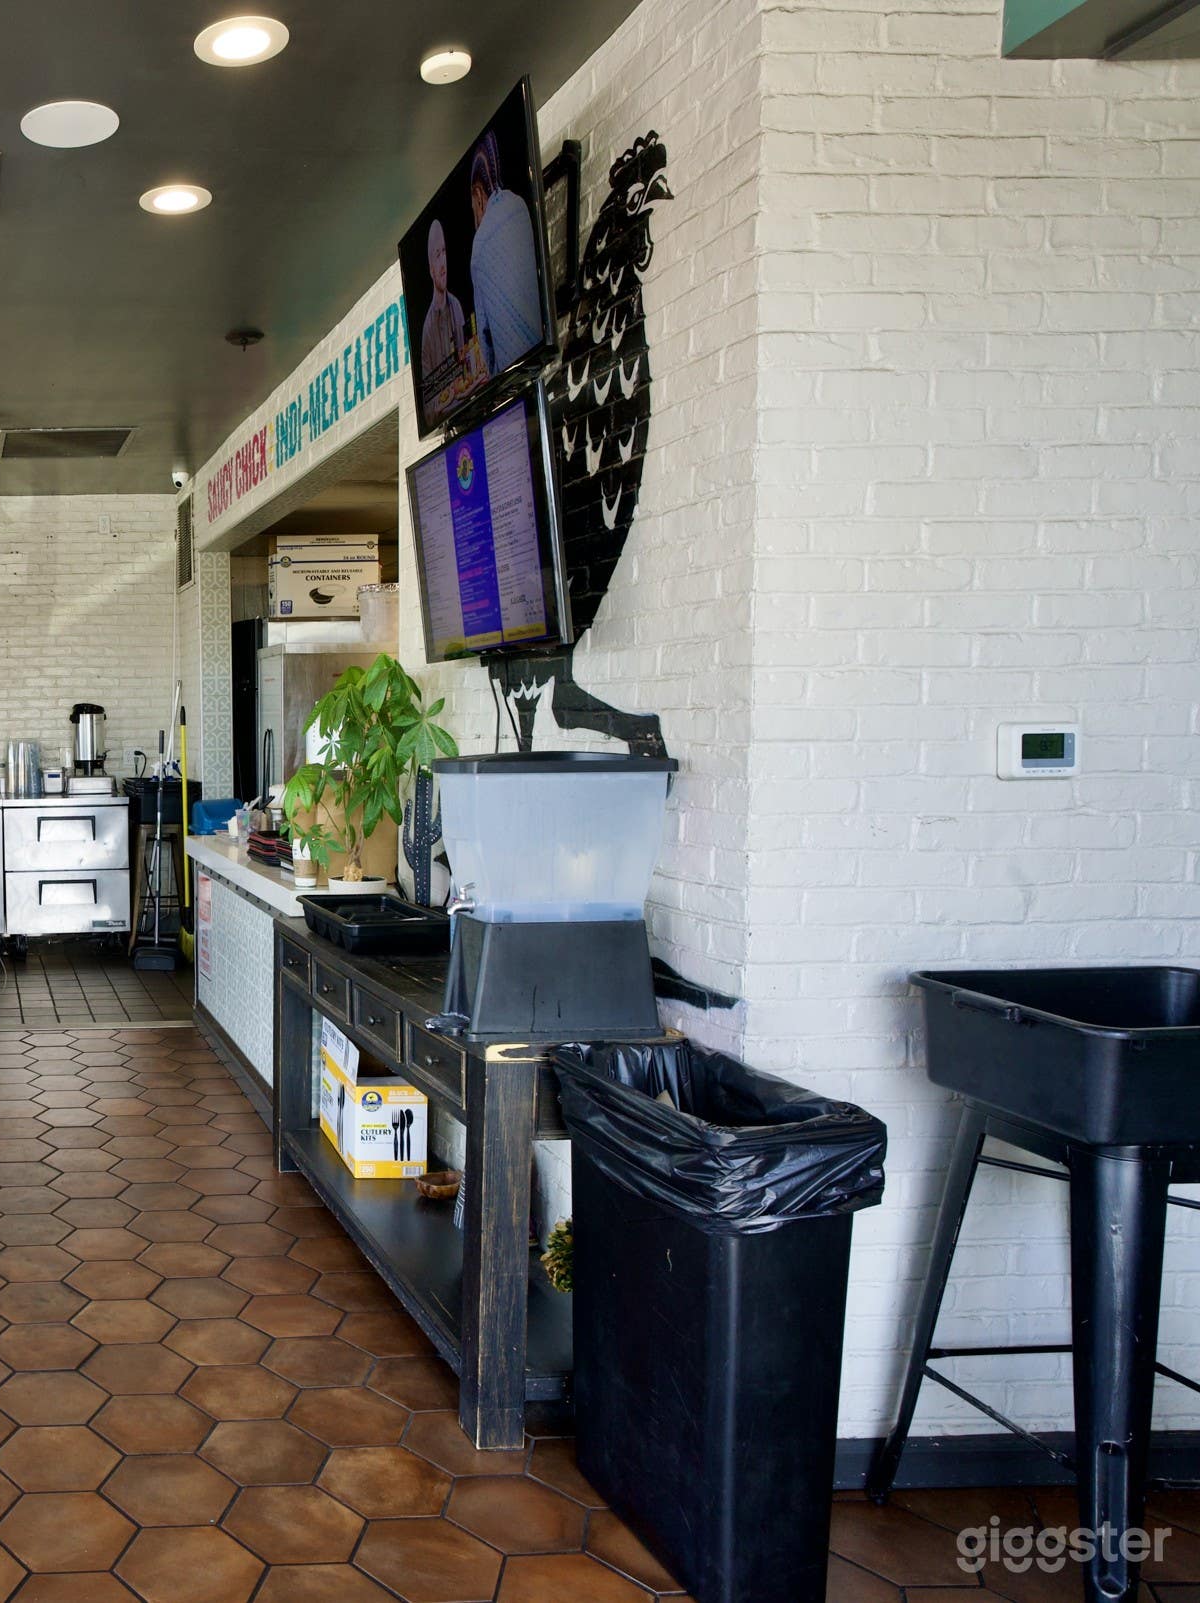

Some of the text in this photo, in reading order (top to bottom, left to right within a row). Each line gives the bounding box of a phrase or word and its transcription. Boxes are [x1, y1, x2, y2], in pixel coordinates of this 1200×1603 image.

[343, 294, 411, 414] EATERY
[207, 425, 268, 523] SAUCY CHICK
[305, 574, 351, 582] CONTAINERS
[360, 1128, 392, 1136] CUTLERY
